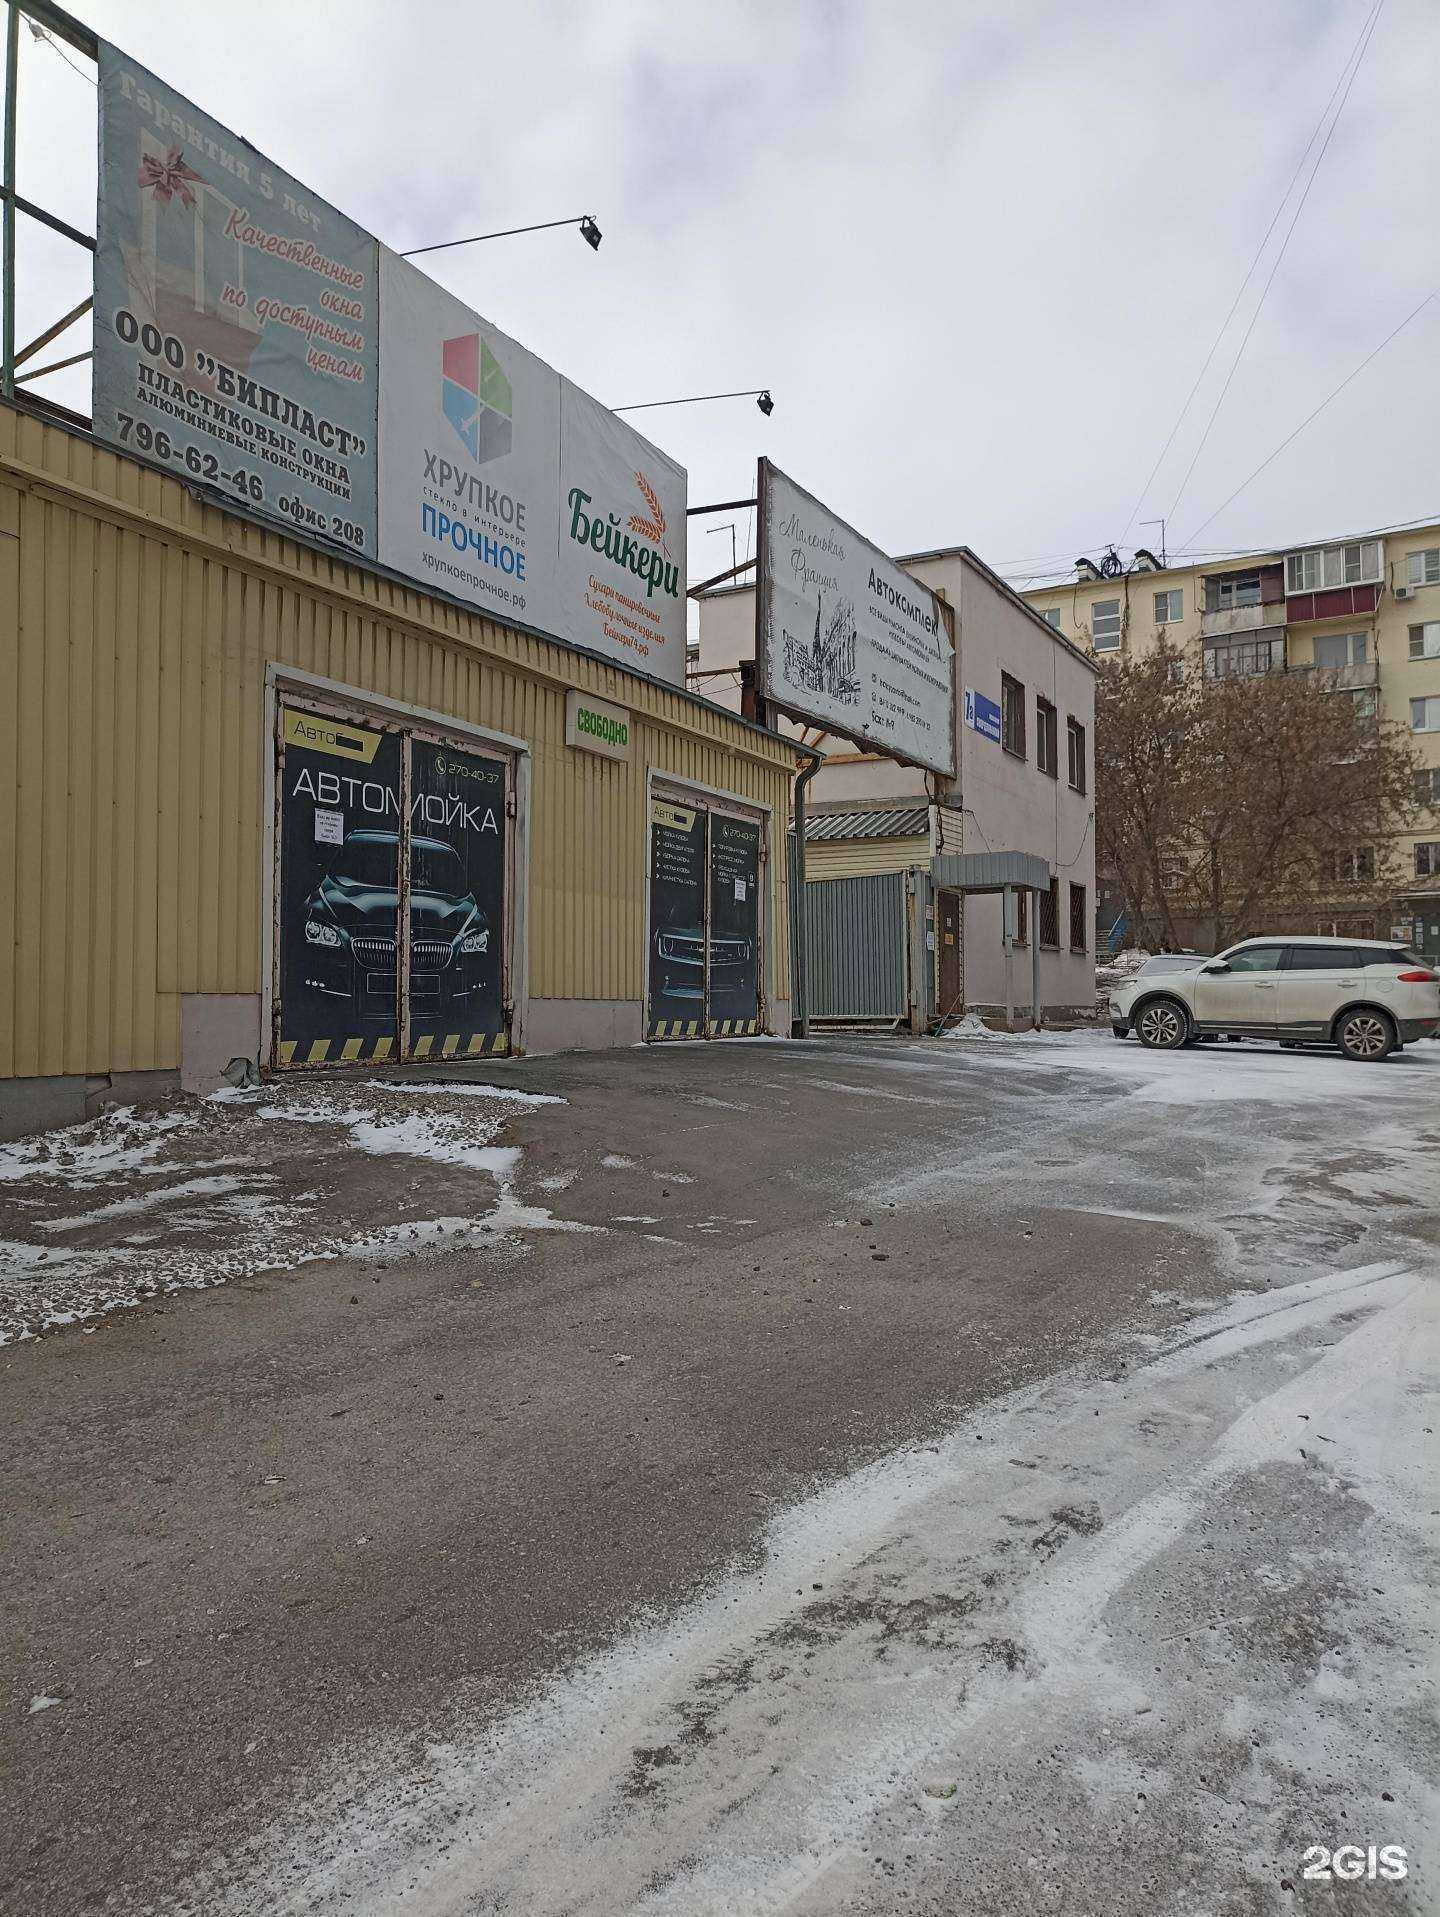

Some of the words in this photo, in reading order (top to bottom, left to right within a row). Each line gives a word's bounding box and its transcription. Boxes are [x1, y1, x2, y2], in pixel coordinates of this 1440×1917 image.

[120, 70, 250, 185] Гарантия
[259, 171, 274, 200] 5
[281, 193, 321, 232] лет
[224, 207, 364, 289] Качественные
[221, 284, 246, 308] по
[256, 299, 363, 351] доступным
[319, 289, 363, 320] окна
[115, 310, 184, 368] ООО
[306, 347, 363, 381] ценам
[137, 386, 256, 455] АЛЮМИНИЕВЫЕ
[260, 448, 351, 501] КОНСТРУКЦИИ
[138, 363, 297, 458] ПЛАСТИКОВЫЕ
[302, 448, 351, 485] ОКНА
[117, 411, 264, 501] 796-62-46
[278, 495, 327, 530] офис
[332, 518, 365, 547] 208
[423, 448, 526, 533] ХРУПКОЕ
[422, 502, 526, 582] ПРОЧНОЕ
[423, 486, 458, 512] стекло
[474, 513, 526, 549] интерьере
[568, 487, 680, 598] Бейкери
[422, 551, 527, 609] хрупкоепрочное.рф
[577, 707, 628, 747] СВОБОДНО
[292, 768, 498, 835] АВТОМОЙКА
[448, 763, 499, 784] 270-40-37
